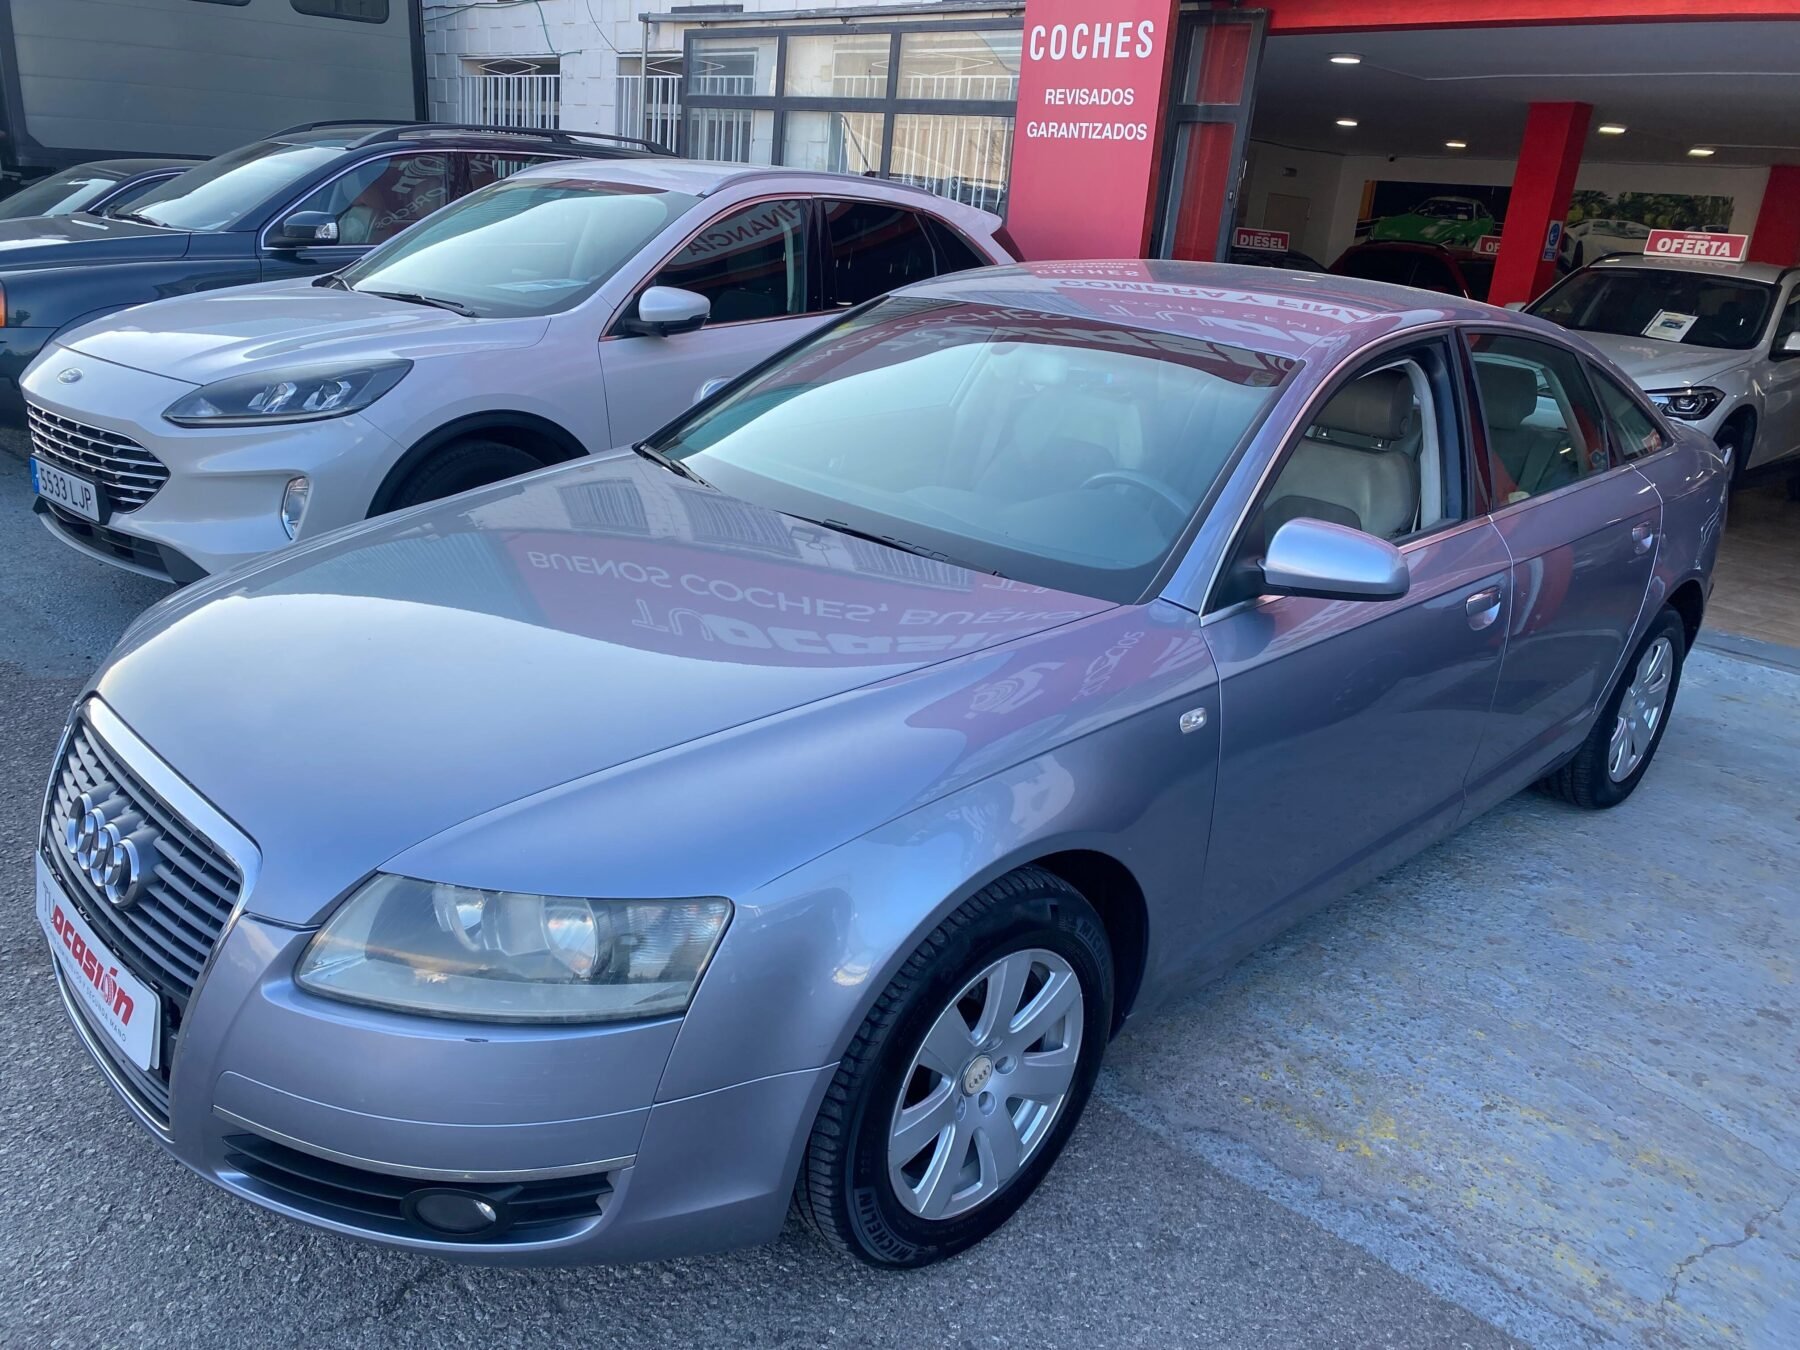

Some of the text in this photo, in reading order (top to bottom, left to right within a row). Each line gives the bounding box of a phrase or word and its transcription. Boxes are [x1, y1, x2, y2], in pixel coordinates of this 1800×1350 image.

[1029, 20, 1155, 60] COCHES
[1045, 88, 1135, 105] REVISADOS
[1026, 121, 1148, 141] GARANTIZADOS
[1240, 234, 1285, 249] DIESEL
[1656, 237, 1731, 257] OFERTA
[40, 467, 92, 512] 5533 LJP
[858, 1192, 913, 1261] MICHELIN
